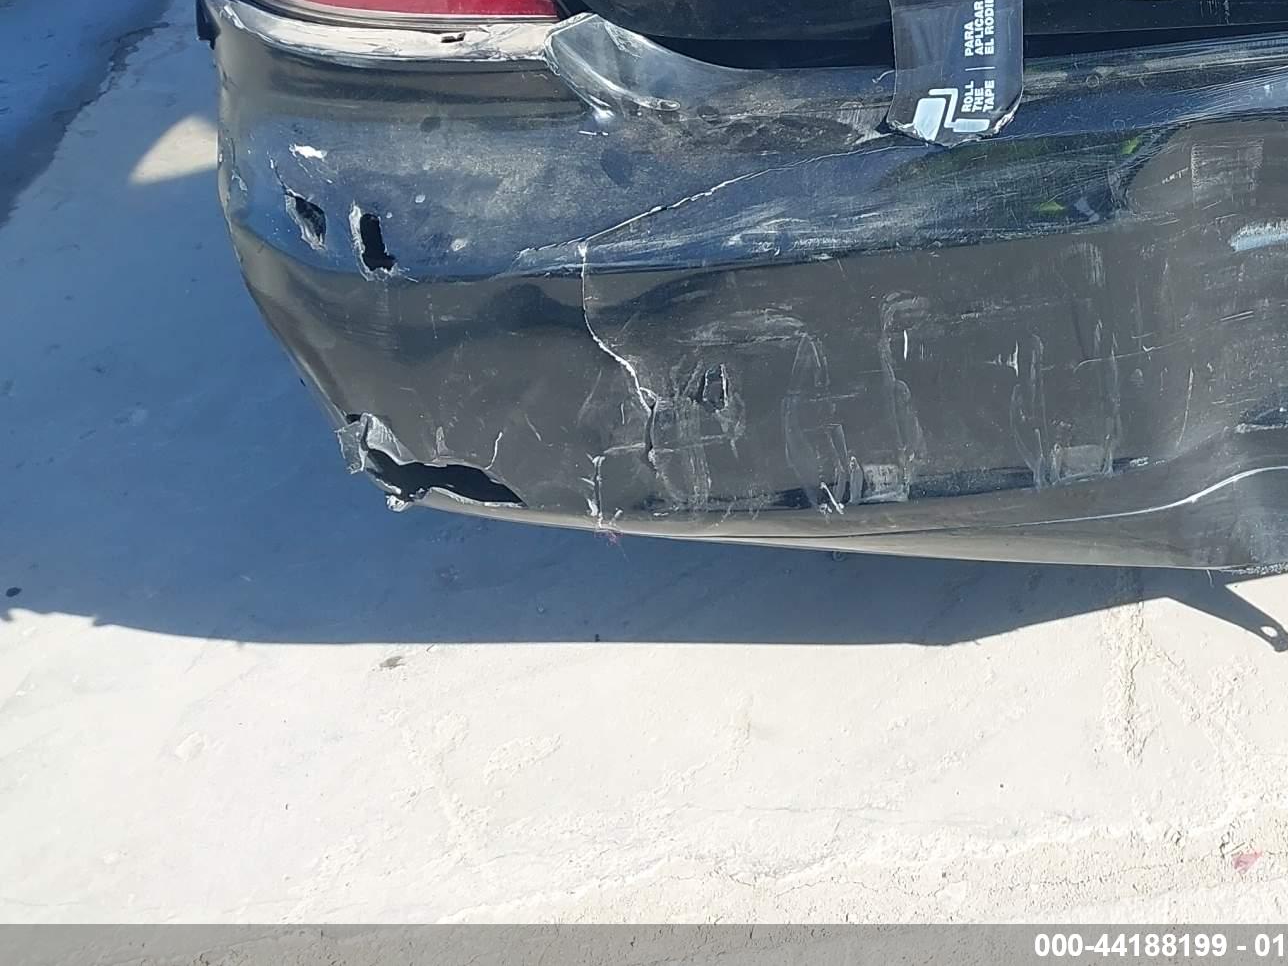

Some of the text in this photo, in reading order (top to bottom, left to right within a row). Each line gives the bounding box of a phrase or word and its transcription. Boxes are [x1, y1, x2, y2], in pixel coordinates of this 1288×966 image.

[963, 20, 975, 57] PARA
[973, 0, 985, 56] APLICAR
[984, 37, 995, 55] EL
[960, 80, 974, 113] ROLL
[971, 87, 985, 113] THE
[982, 79, 995, 113] TAPE
